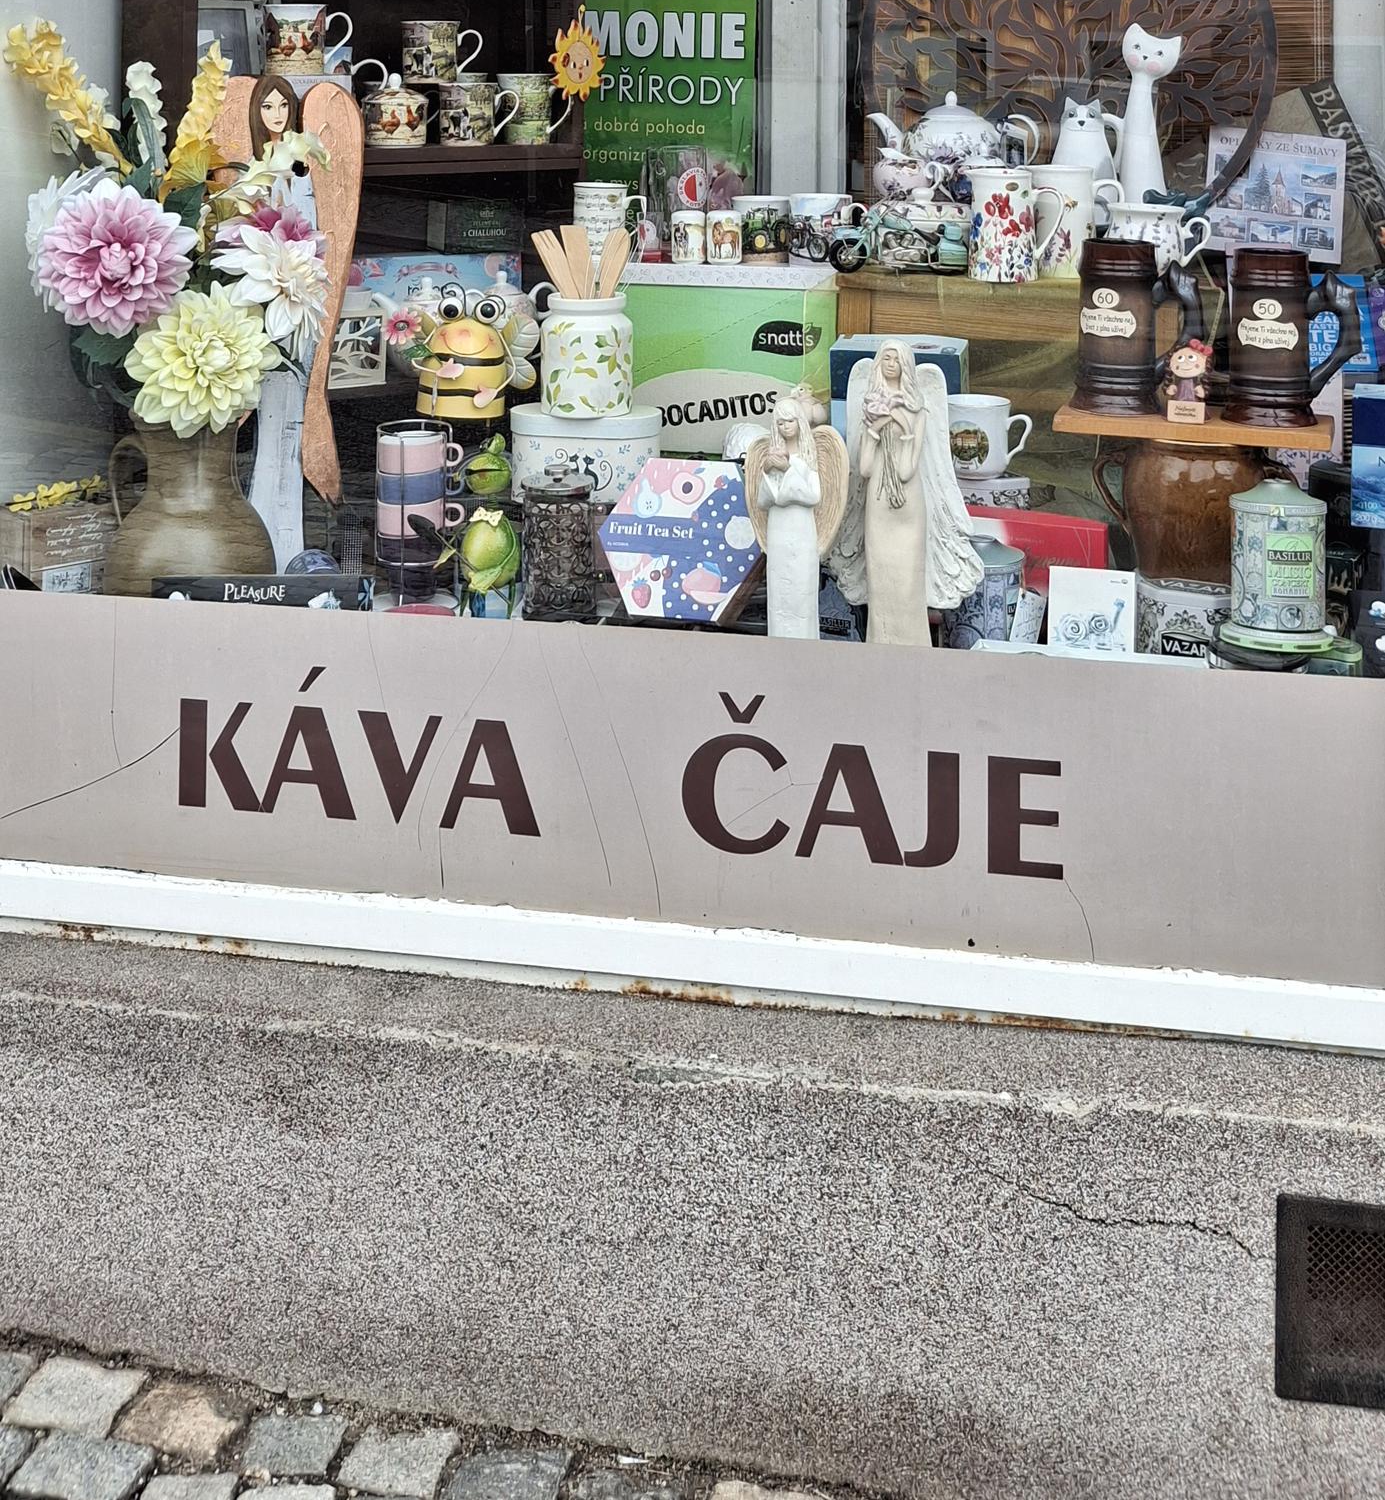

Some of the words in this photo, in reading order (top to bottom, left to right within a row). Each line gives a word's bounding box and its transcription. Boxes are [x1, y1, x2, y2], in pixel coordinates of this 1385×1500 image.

[584, 10, 746, 59] MONIE
[600, 66, 744, 106] PŘÍRODY
[594, 116, 639, 133] dobrá
[646, 118, 705, 136] pohoda
[1097, 292, 1114, 304] 60
[1258, 303, 1277, 315] 50
[609, 521, 642, 536] Fruit
[646, 523, 669, 538] Tea
[672, 525, 695, 539] Set
[1268, 551, 1312, 561] BASILUR
[223, 583, 286, 602] PLEASURE
[178, 667, 541, 838] KÁVA
[682, 692, 1064, 881] ČAJE
